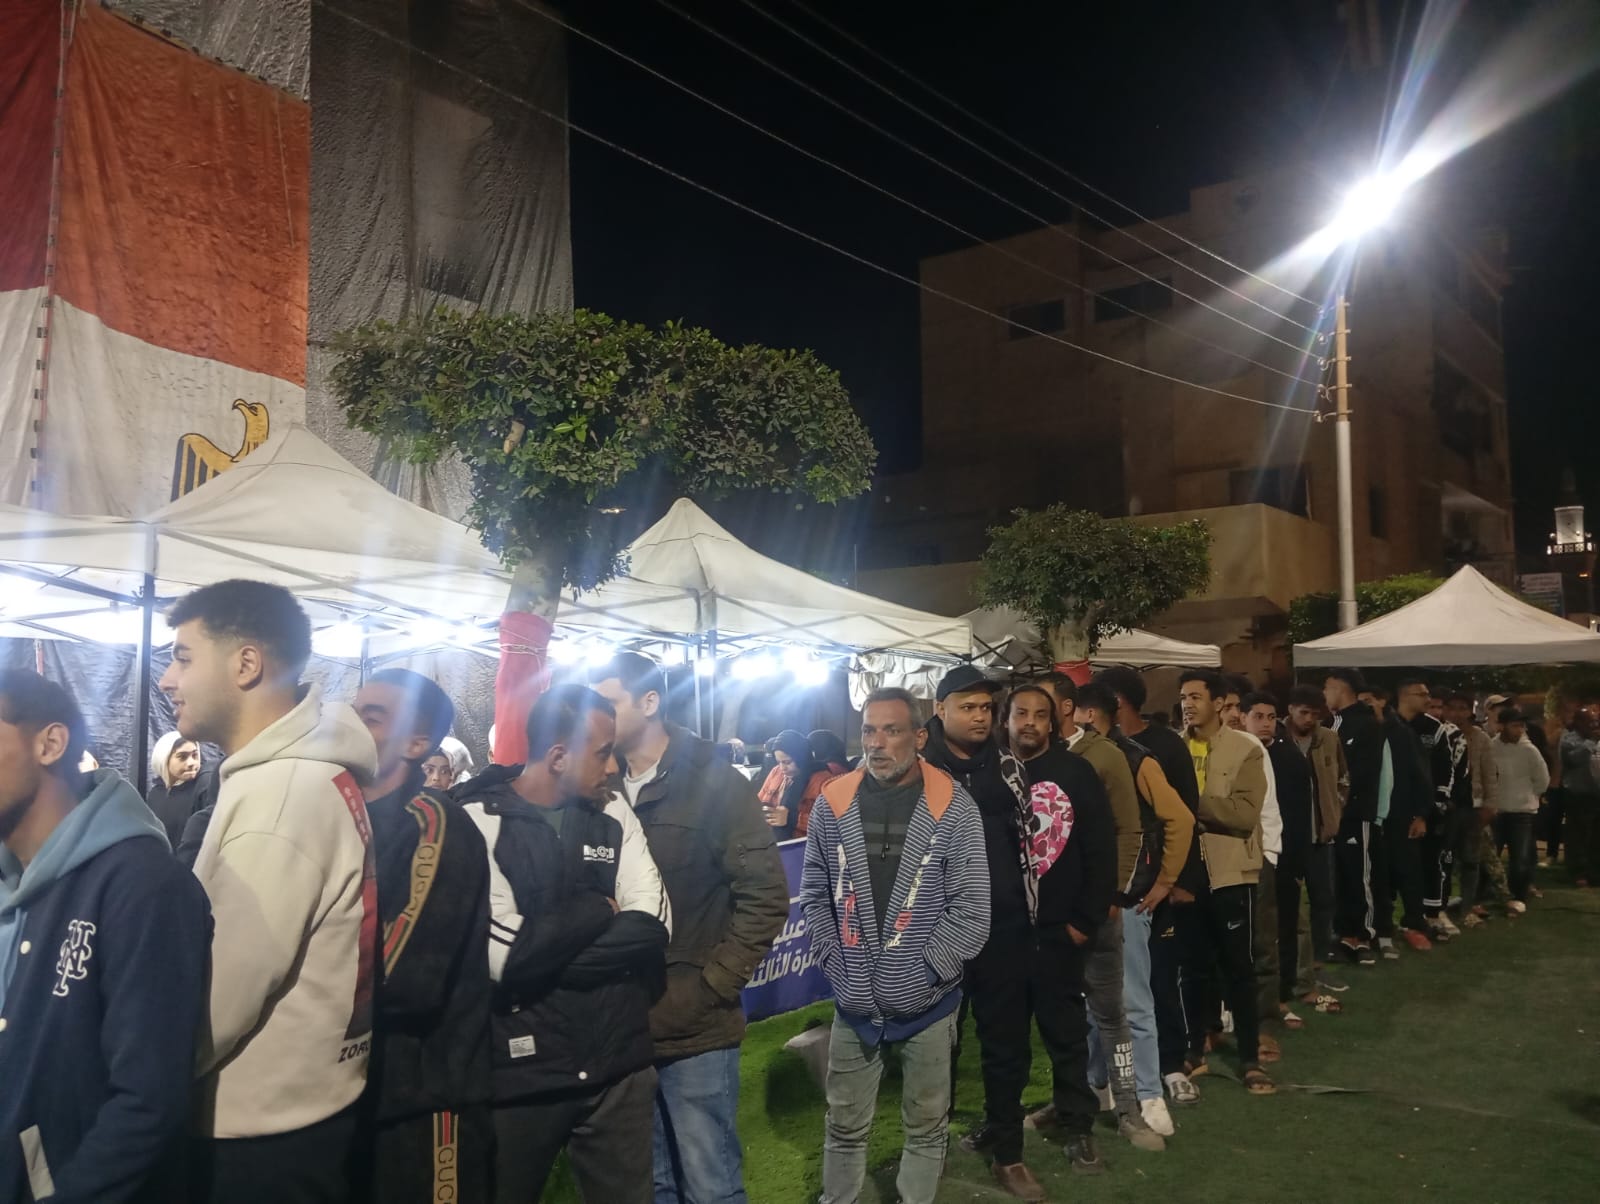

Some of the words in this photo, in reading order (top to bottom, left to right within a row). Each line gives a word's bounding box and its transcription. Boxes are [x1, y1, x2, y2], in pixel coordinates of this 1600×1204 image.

[1113, 1052, 1134, 1067] DE
[1119, 1066, 1134, 1078] IG
[437, 1146, 455, 1204] GUC
